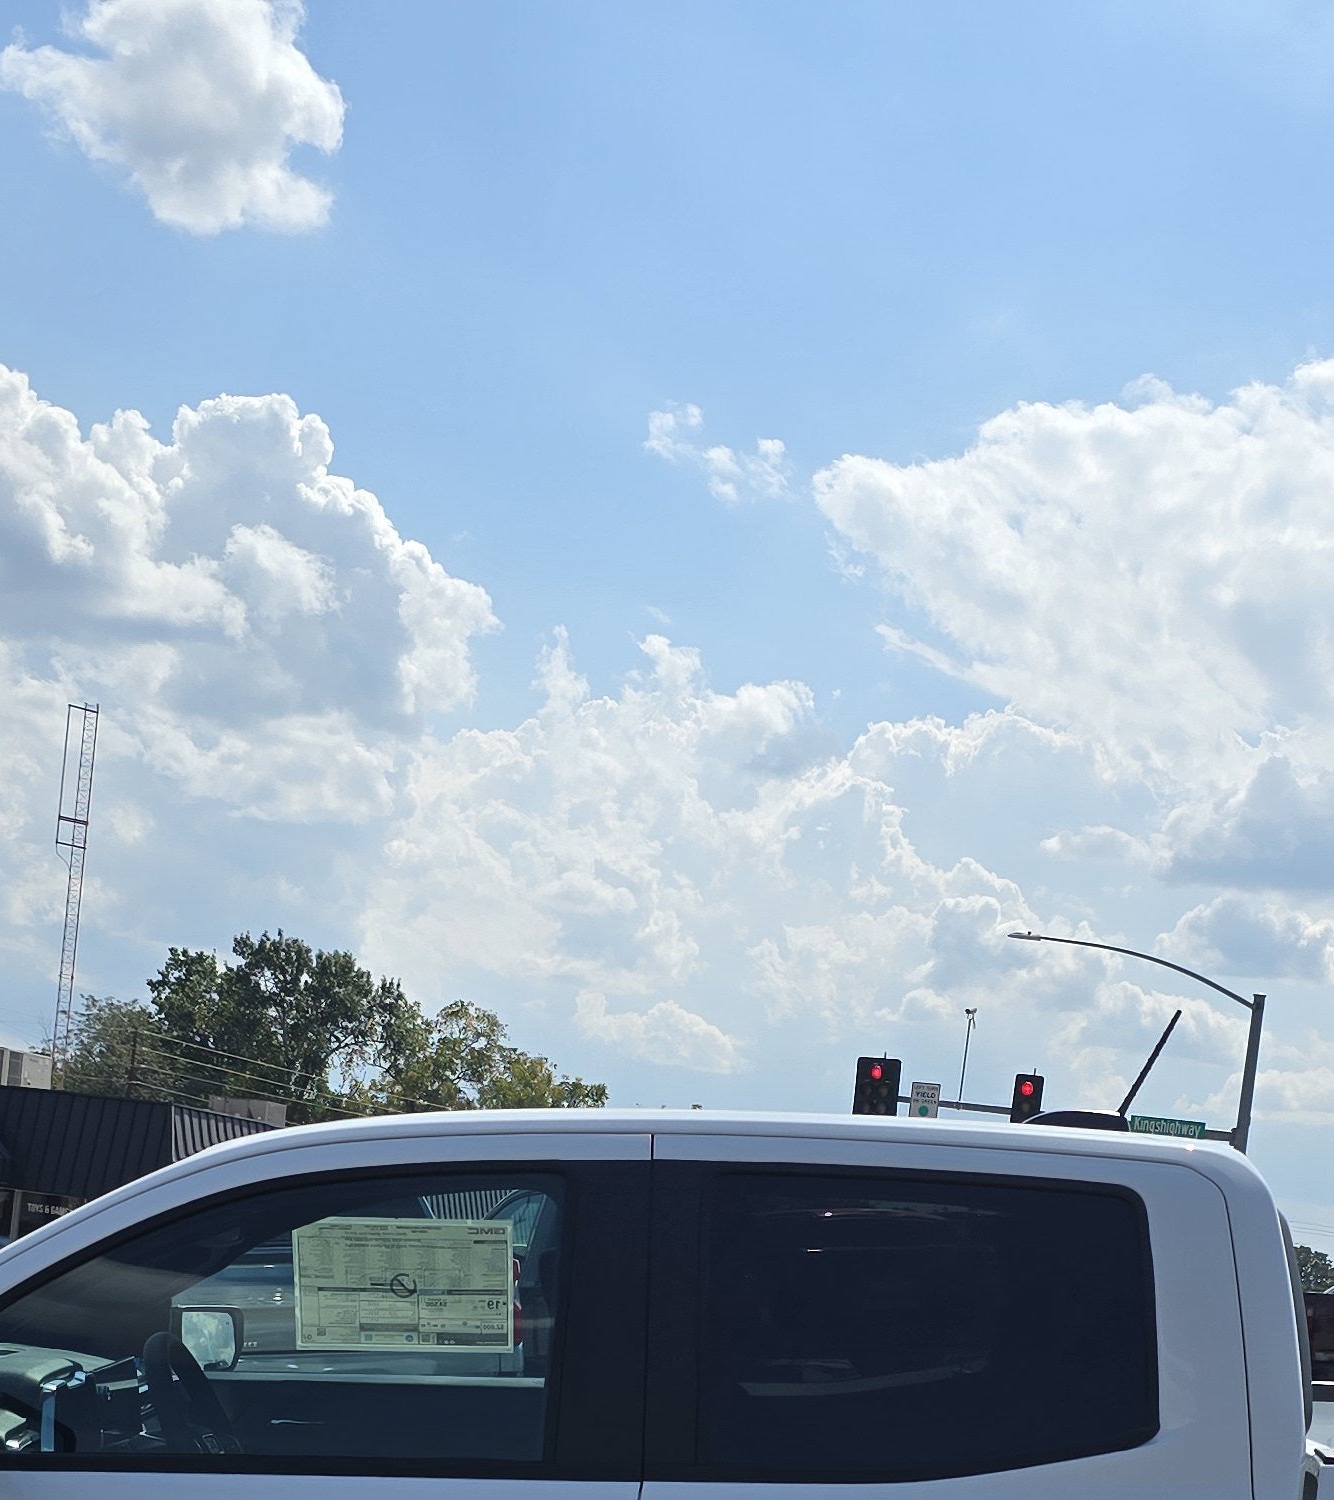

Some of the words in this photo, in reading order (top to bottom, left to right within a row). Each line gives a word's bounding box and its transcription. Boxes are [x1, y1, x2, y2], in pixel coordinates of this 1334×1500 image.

[916, 1091, 936, 1099] YIELD
[1133, 1116, 1202, 1139] Kingshighway
[27, 1202, 43, 1213] TOYS
